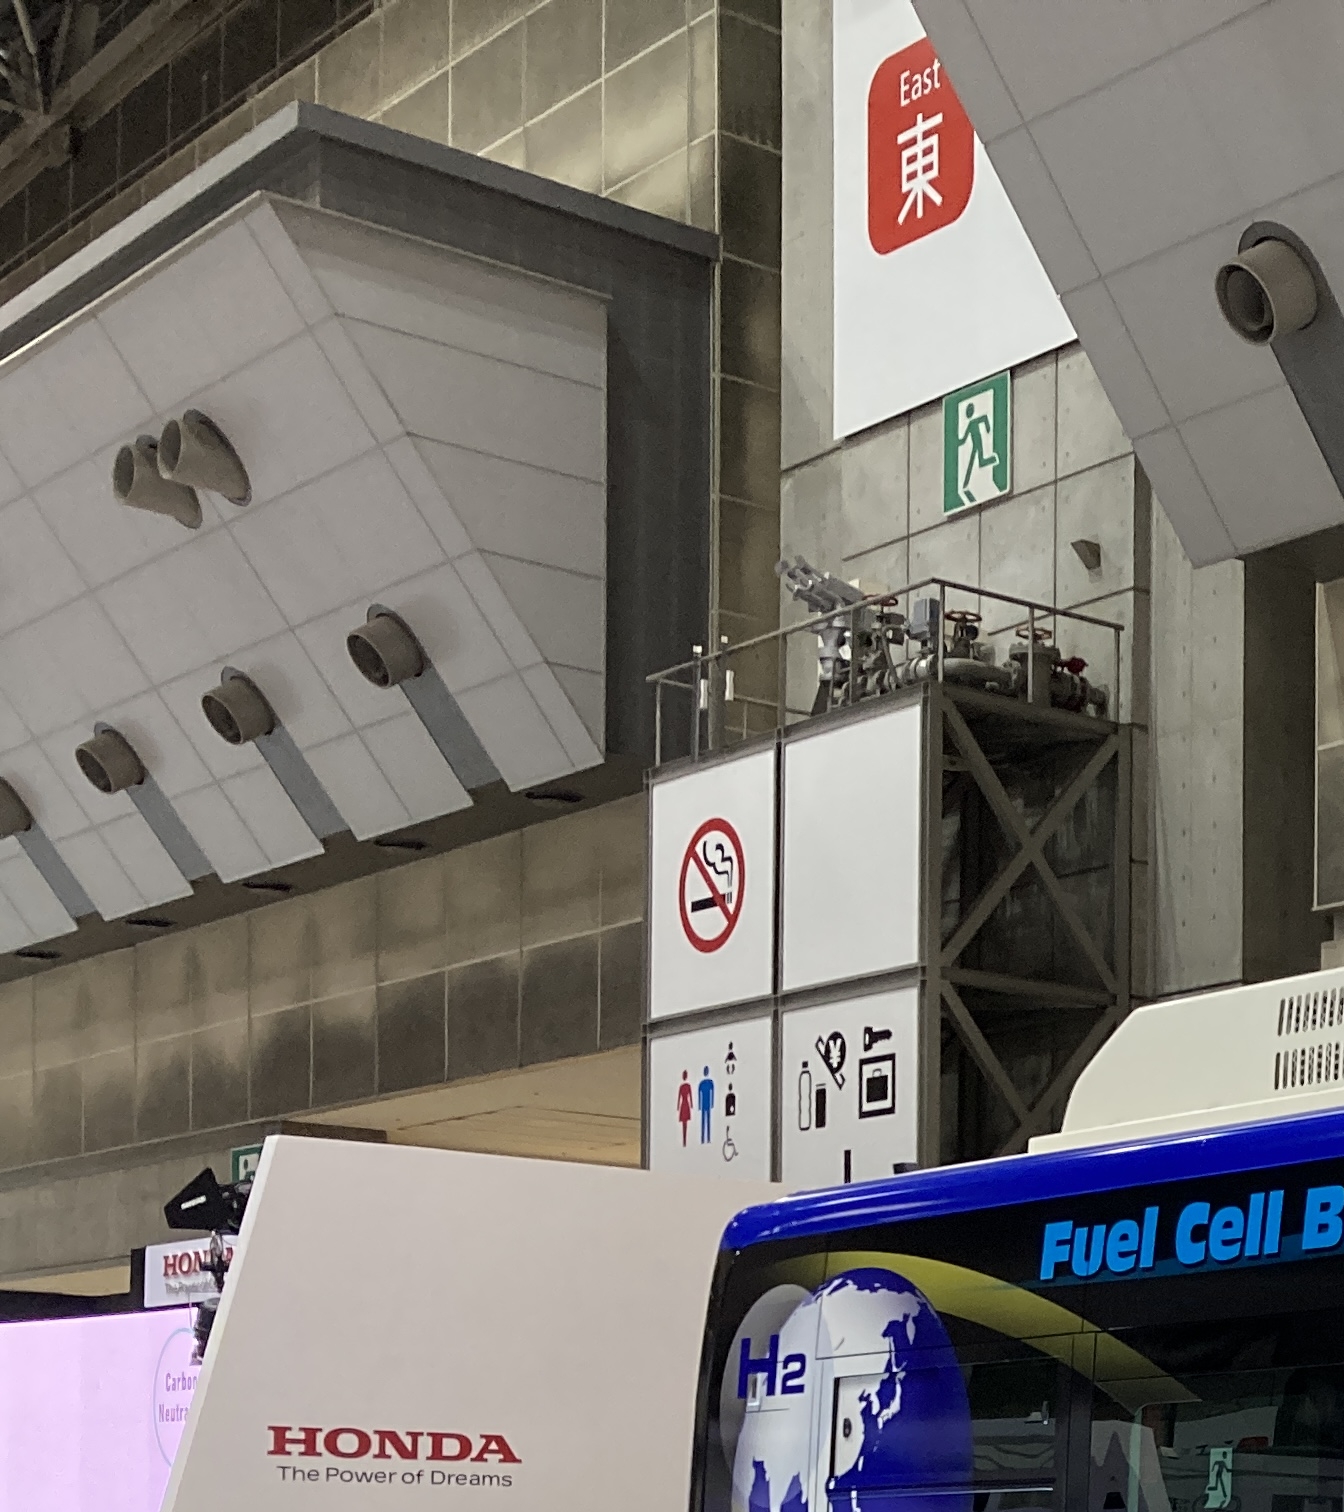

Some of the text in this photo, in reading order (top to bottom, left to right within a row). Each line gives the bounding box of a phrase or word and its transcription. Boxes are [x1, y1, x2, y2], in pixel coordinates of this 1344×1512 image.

[900, 58, 941, 107] East
[897, 112, 943, 225] 東
[1040, 1206, 1159, 1280] Fuel
[1175, 1190, 1284, 1265] Cell
[163, 1246, 233, 1277] HON
[737, 1334, 806, 1399] H2
[158, 1403, 189, 1422] Neutra
[267, 1426, 522, 1463] HONDA
[277, 1466, 513, 1487] The Power of Dreams
